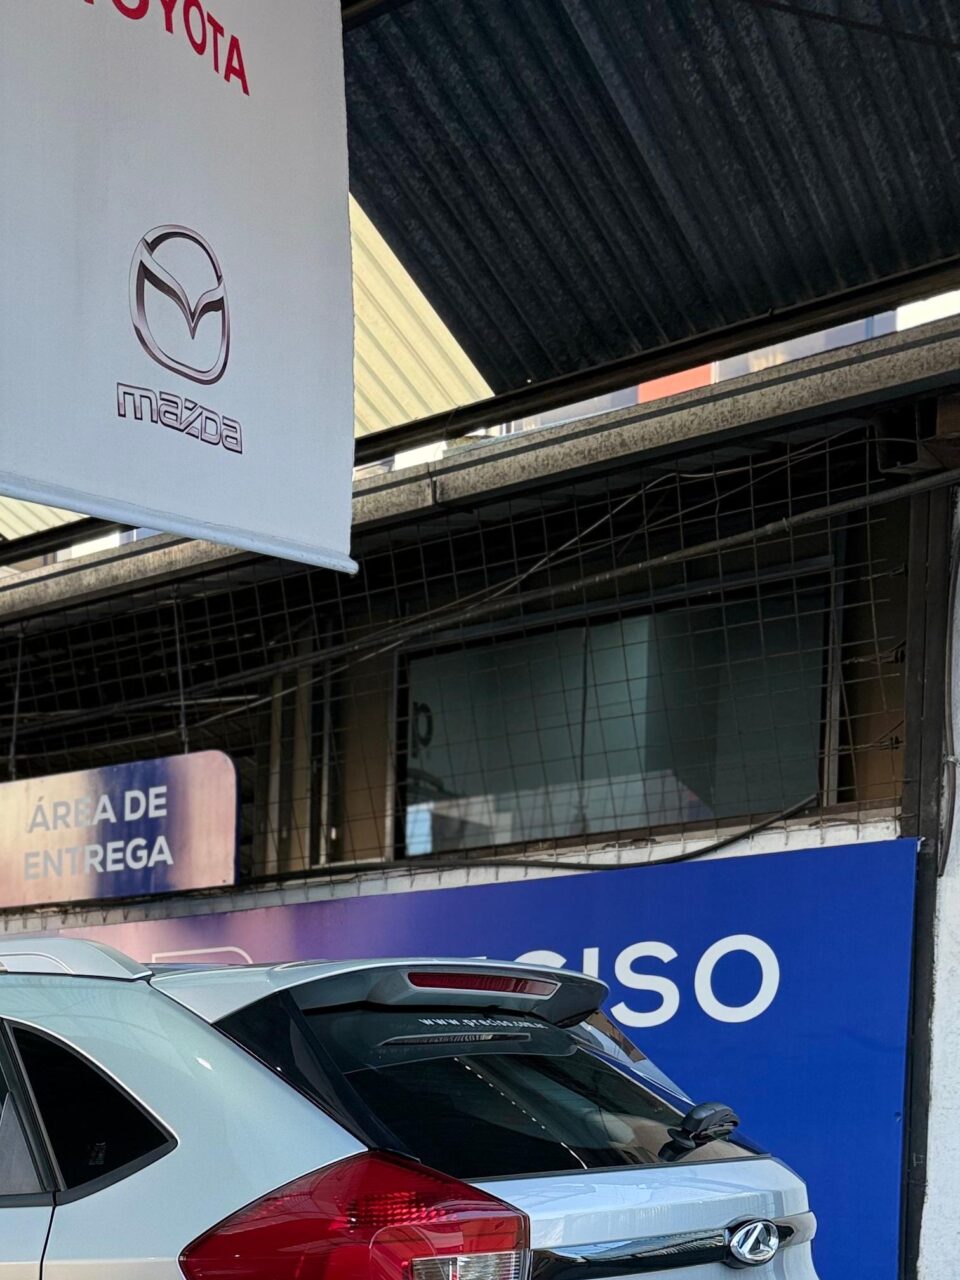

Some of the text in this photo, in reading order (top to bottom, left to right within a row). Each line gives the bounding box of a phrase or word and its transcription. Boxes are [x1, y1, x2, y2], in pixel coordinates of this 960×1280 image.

[28, 785, 168, 834] ÁREA DE
[23, 835, 174, 881] ENTREGA
